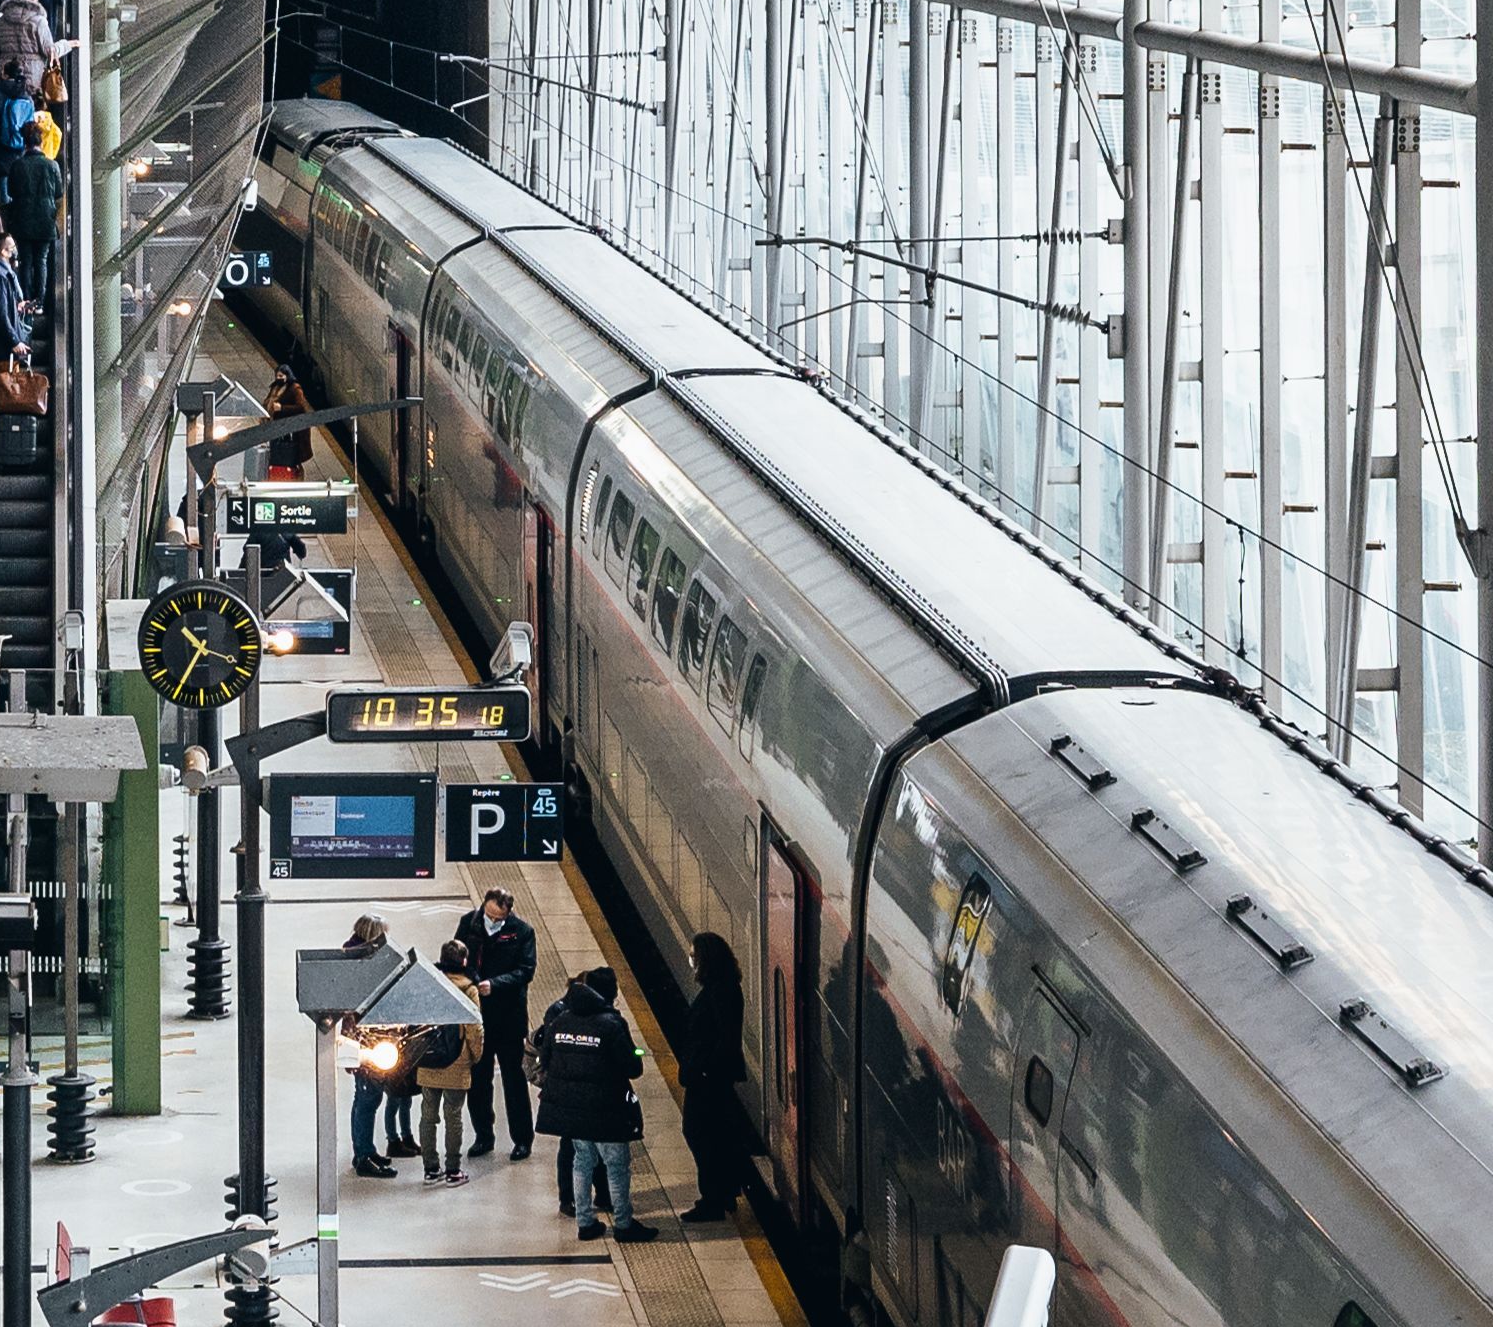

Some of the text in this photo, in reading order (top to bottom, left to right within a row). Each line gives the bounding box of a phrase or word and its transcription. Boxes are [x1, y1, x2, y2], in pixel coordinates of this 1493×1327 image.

[257, 257, 270, 267] 45
[280, 505, 312, 517] Sortie
[362, 697, 504, 726] 10 35 18
[472, 788, 500, 798] Repère
[532, 797, 557, 814] 45
[470, 803, 505, 855] P
[272, 867, 289, 878] 45
[554, 1033, 601, 1044] EXPLORER
